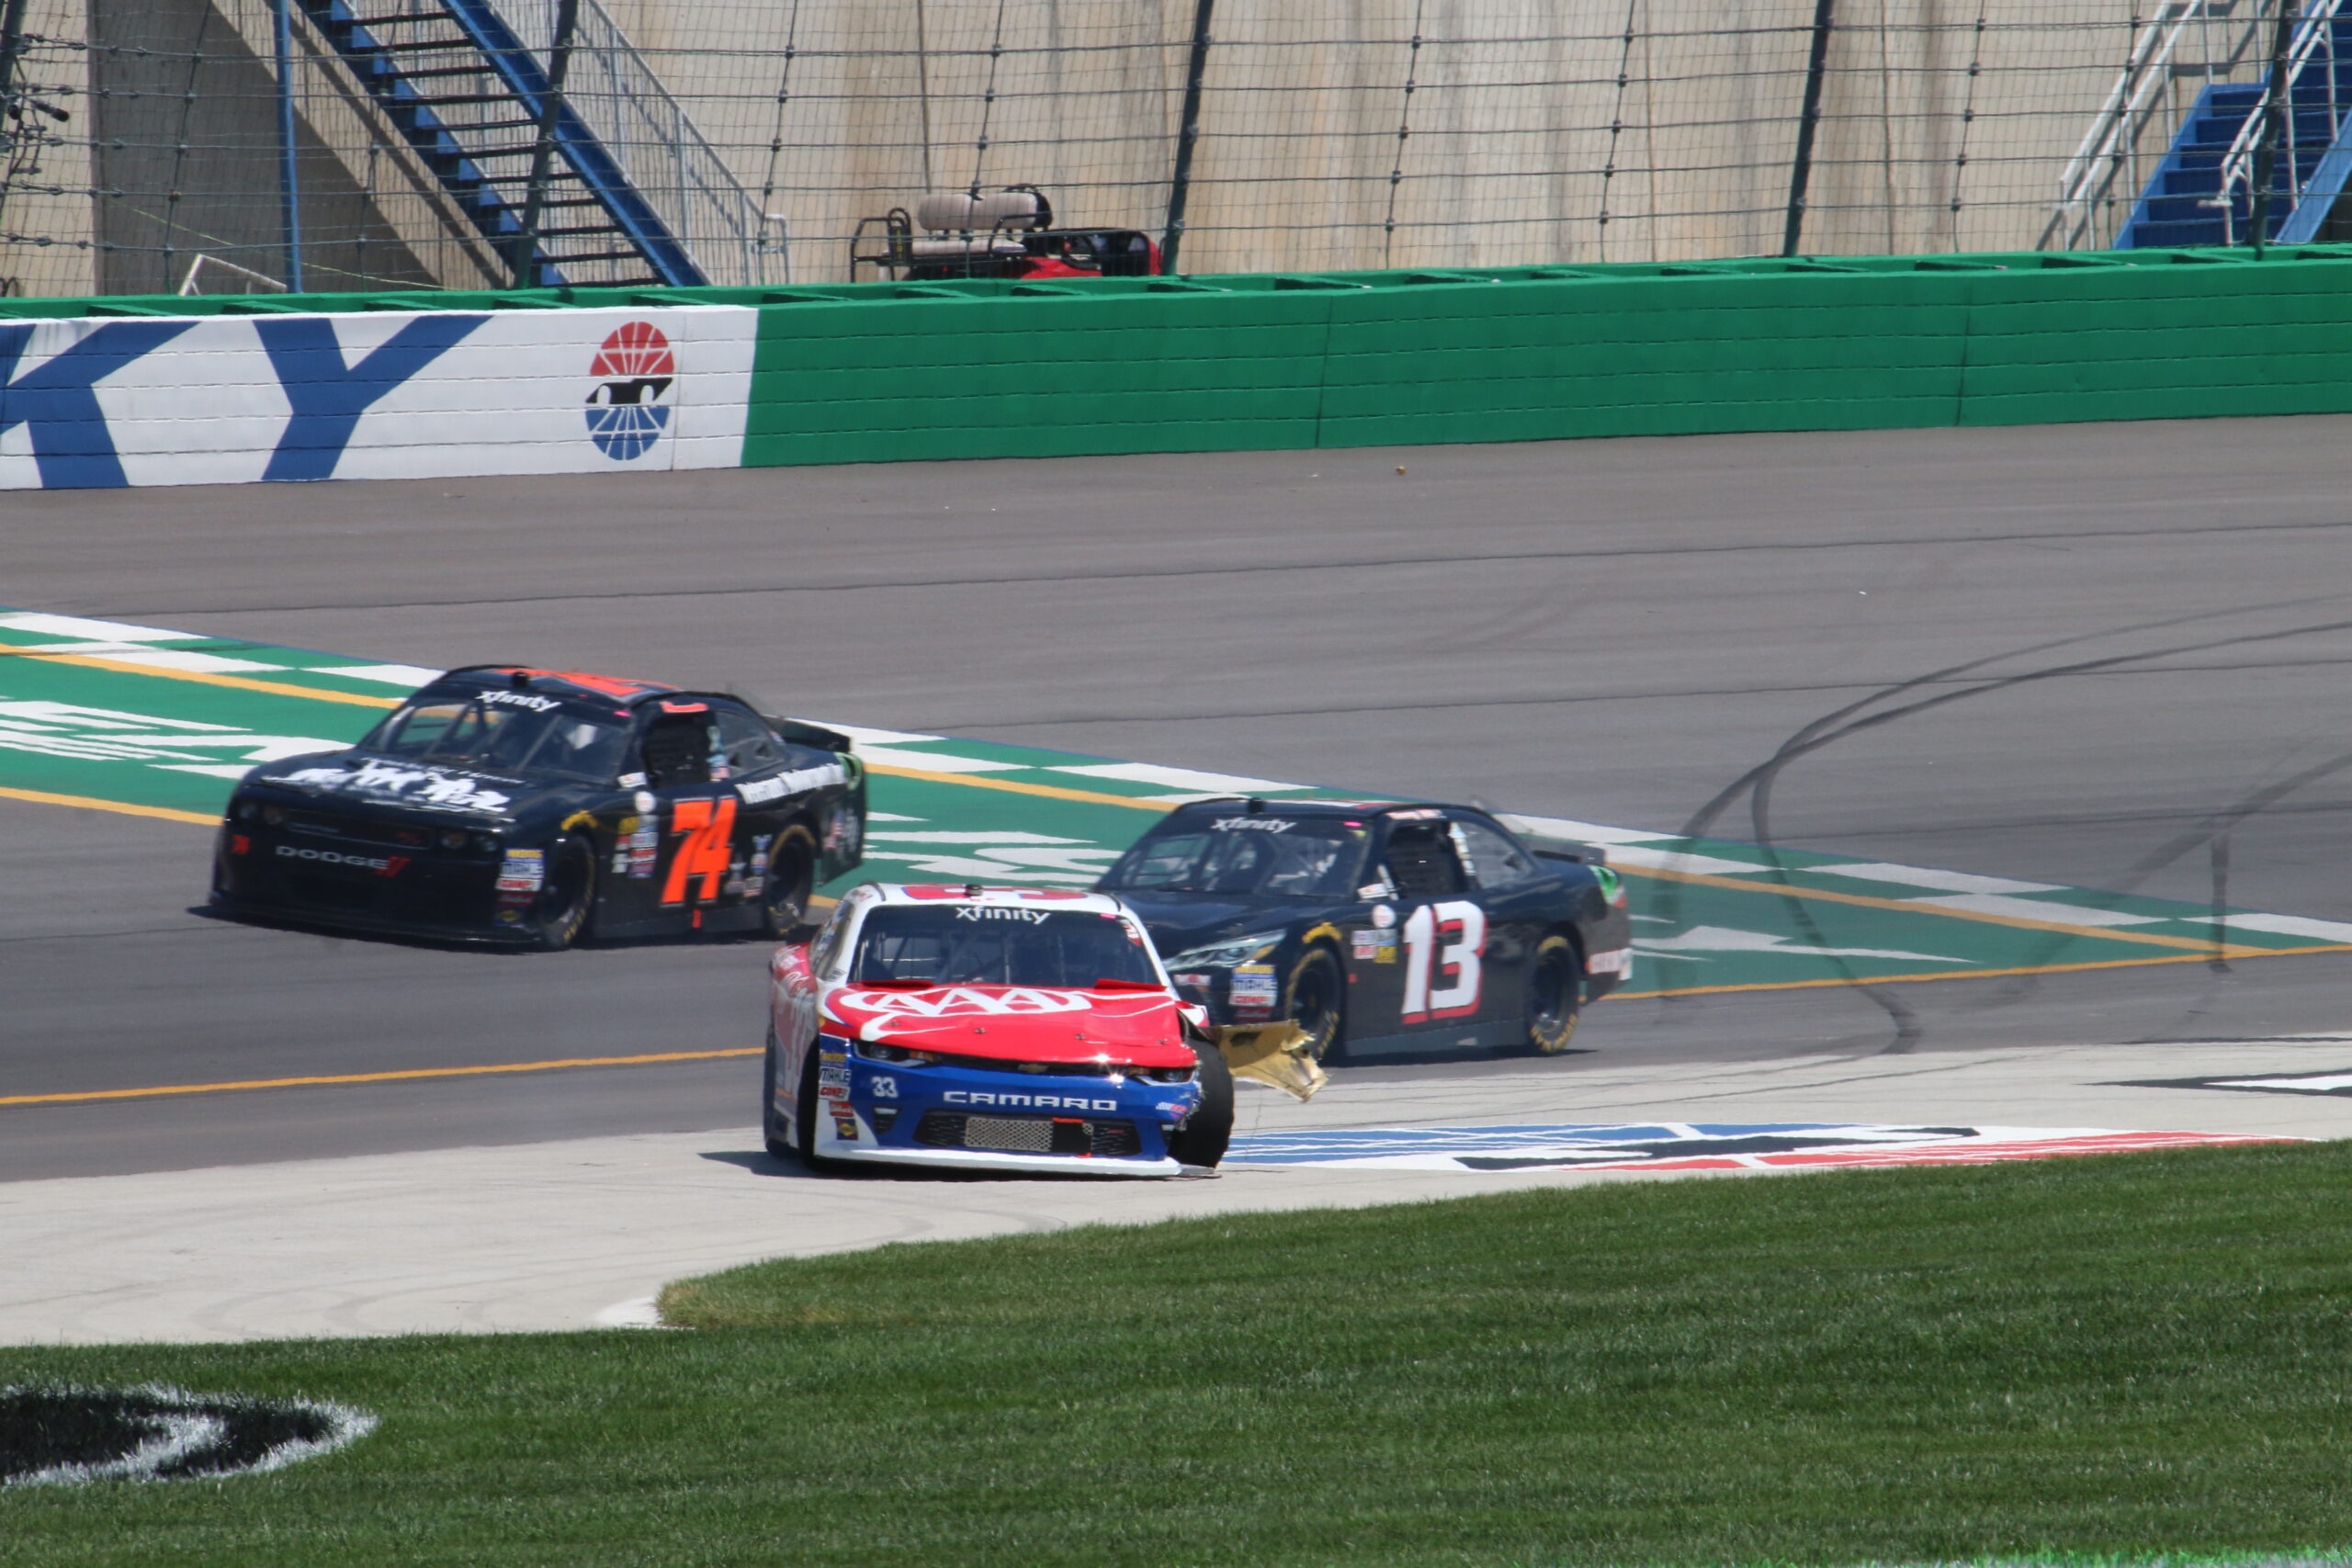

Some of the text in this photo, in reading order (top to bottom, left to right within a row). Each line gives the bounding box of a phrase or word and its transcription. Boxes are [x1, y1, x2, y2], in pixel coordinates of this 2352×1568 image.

[475, 690, 562, 713] xfinity
[1209, 816, 1297, 834] xfinity
[276, 845, 392, 871] DODGE
[660, 795, 738, 908] 74
[955, 906, 1052, 926] xfinity
[1400, 900, 1489, 1024] 13
[860, 987, 1075, 1017] AAA
[871, 1076, 899, 1099] 33
[943, 1090, 1117, 1111] CAMARO
